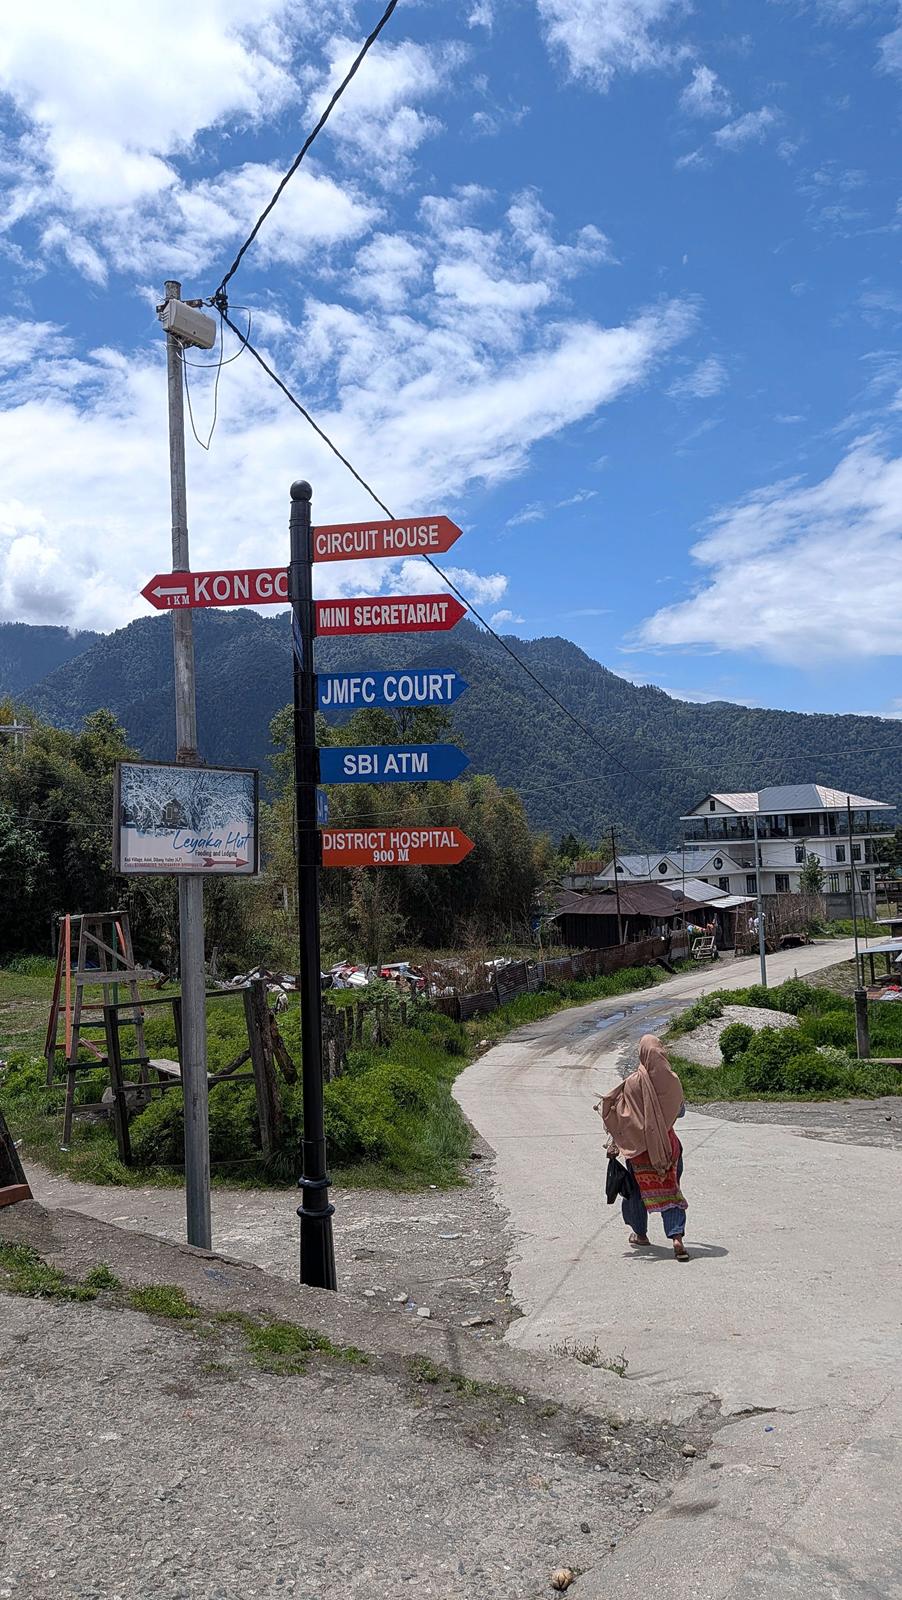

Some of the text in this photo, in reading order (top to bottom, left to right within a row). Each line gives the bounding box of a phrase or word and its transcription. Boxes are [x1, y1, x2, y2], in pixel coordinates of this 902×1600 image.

[316, 525, 438, 554] CIRCUIT HOUSE
[319, 602, 448, 628] MINI SECRETARIAT
[322, 674, 455, 705] JMFC COURT
[343, 752, 428, 775] SBI ATM
[173, 829, 256, 853] Leyaka Hut
[323, 831, 459, 850] DISTRICT HOSPITAL
[373, 849, 409, 863] 900 M
